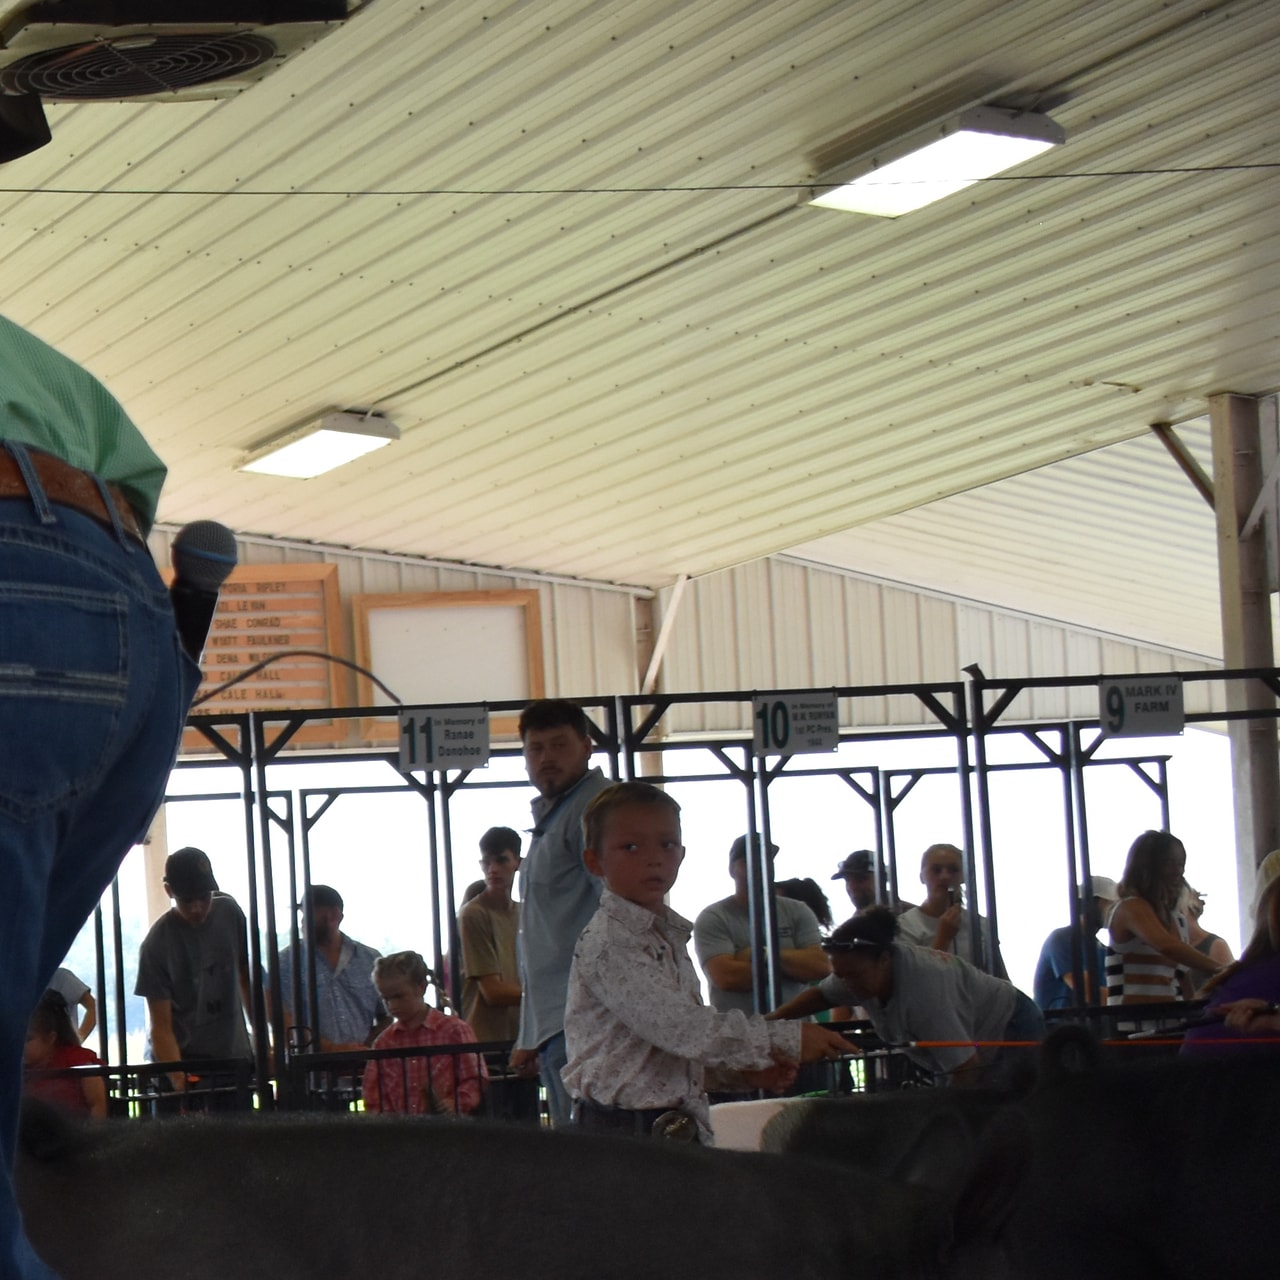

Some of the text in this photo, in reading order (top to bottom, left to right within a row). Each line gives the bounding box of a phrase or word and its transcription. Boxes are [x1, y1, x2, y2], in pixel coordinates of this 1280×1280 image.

[246, 618, 281, 628] CONRAD
[221, 689, 247, 700] CALE
[1125, 684, 1178, 698] MARK IV
[1106, 685, 1125, 734] 9
[1134, 701, 1170, 713] FARM
[444, 718, 476, 727] Memory
[477, 716, 487, 725] of
[756, 701, 790, 749] 10
[402, 716, 434, 765] 11
